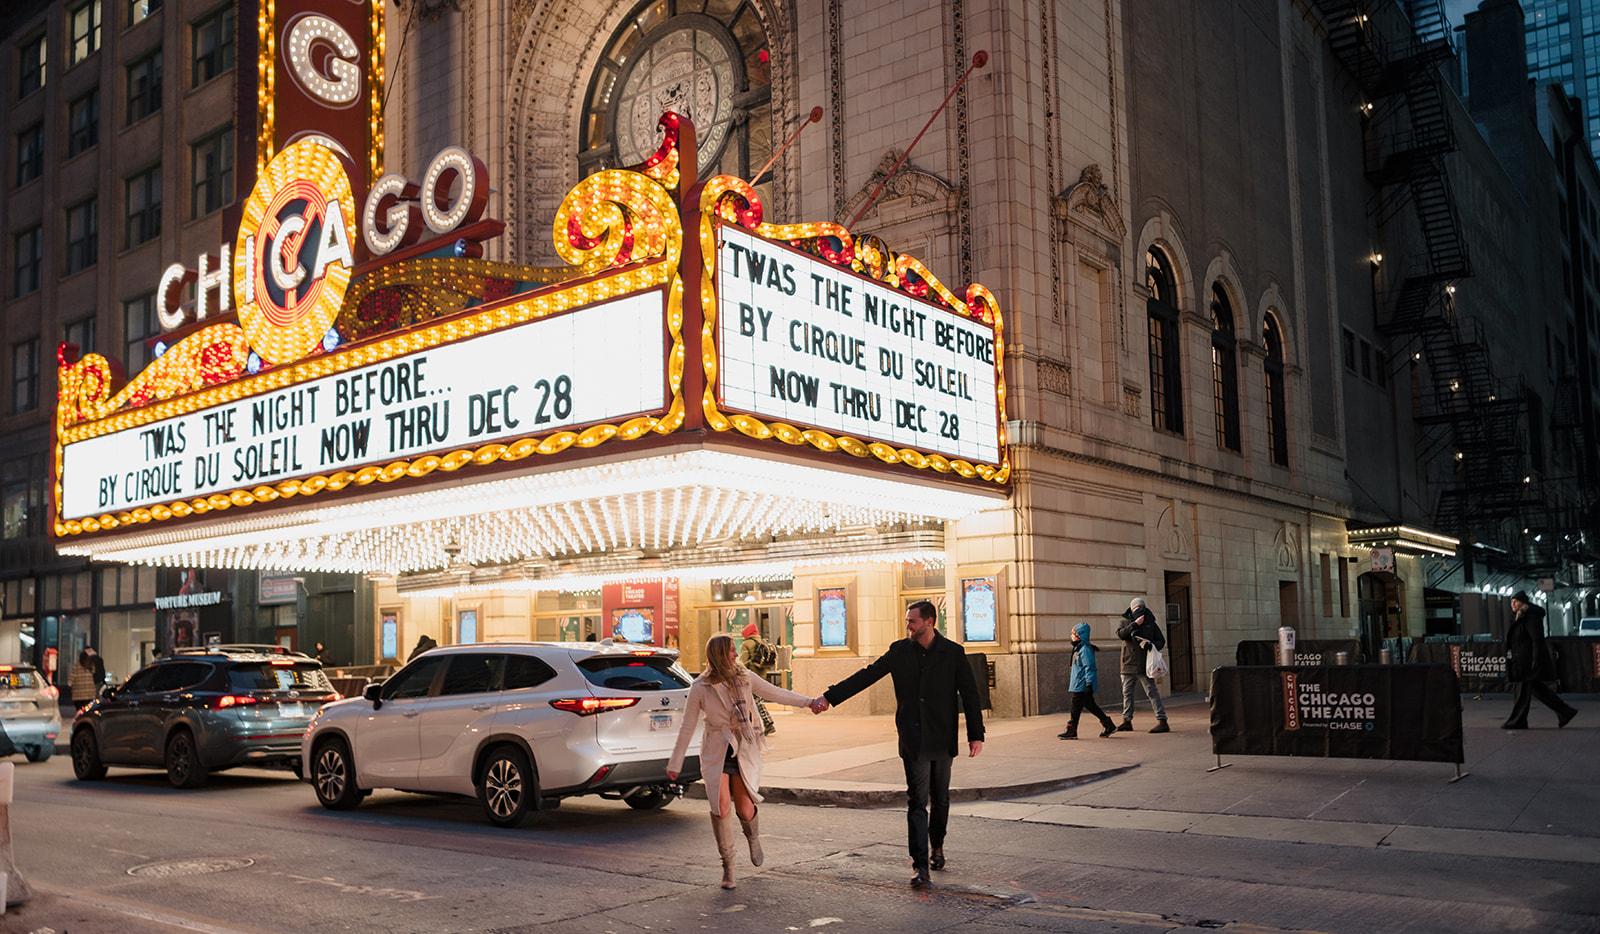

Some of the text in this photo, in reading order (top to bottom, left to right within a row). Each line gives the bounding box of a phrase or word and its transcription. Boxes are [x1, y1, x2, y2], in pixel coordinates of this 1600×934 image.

[157, 146, 476, 330] CHICAGO
[719, 239, 994, 366] 'TWAS THE NIGHT BEFORE
[739, 302, 973, 401] BY CIRQUE DU SOLEIL
[769, 365, 959, 440] NOW THRU DEC 28
[203, 408, 237, 447] THE
[252, 386, 320, 437] NIGHT
[99, 374, 573, 508] BY CIRQUE DU SOLEIL NOW THRU DEC 28
[189, 591, 221, 606] MUSEUM
[1295, 653, 1321, 661] ICAGO
[1460, 656, 1506, 664] CHICAGO
[1461, 664, 1506, 672] THEATRE
[1299, 683, 1320, 692] THE
[1286, 675, 1297, 728] CHICAGO
[1299, 693, 1376, 706] CHICAGO
[1300, 706, 1376, 719] THEATRE
[1330, 721, 1363, 730] CHASE
